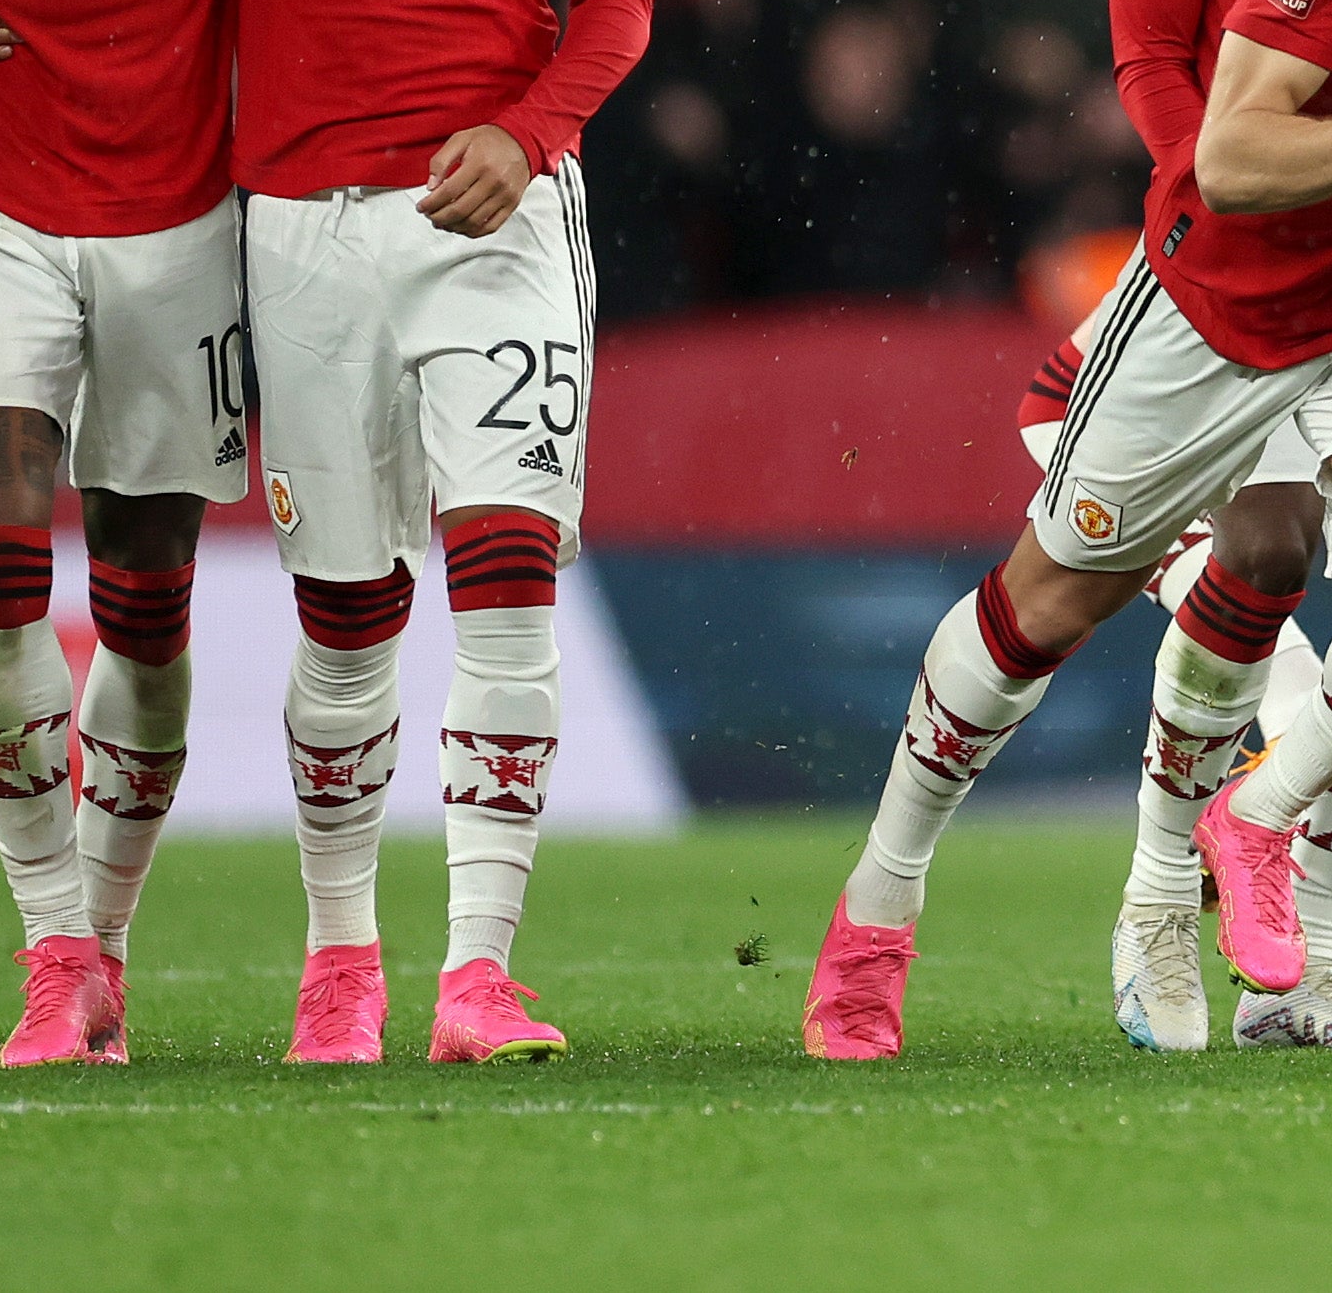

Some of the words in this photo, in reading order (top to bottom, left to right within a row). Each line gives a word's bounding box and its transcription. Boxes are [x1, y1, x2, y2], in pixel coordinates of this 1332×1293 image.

[197, 322, 243, 427] 10
[475, 339, 579, 437] 25
[517, 457, 564, 477] adidas
